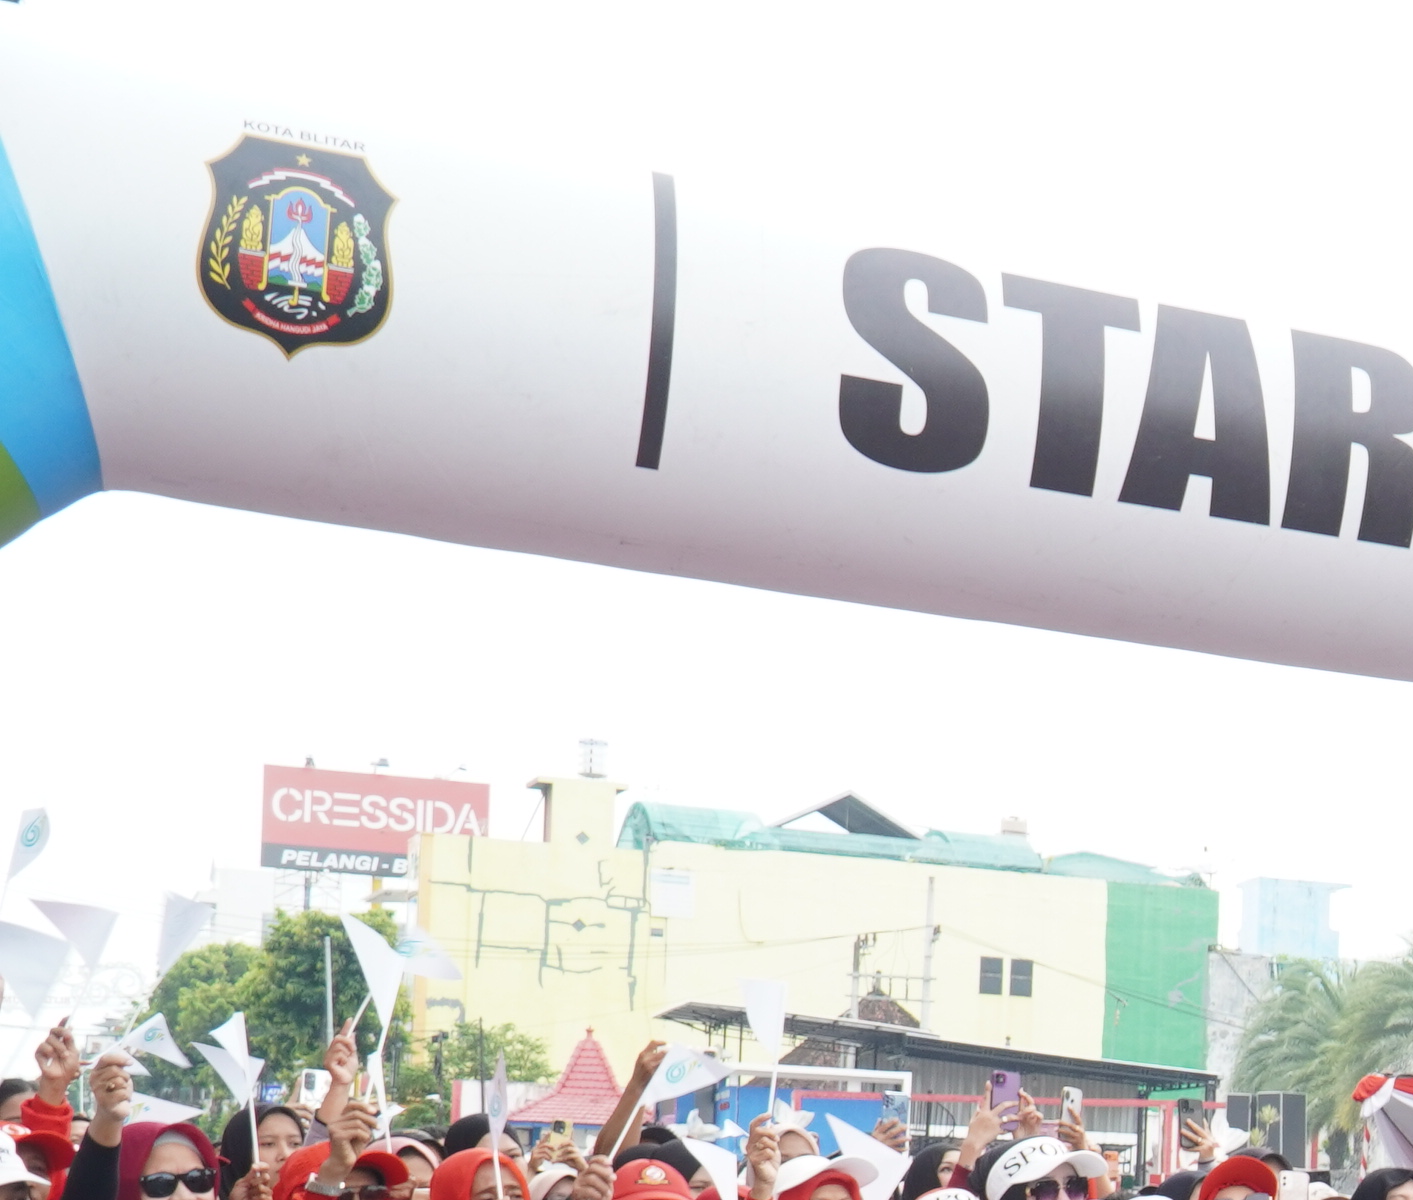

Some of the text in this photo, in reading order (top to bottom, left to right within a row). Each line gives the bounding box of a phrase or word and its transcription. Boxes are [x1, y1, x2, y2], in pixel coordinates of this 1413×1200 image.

[243, 120, 366, 151] KOTA BLITAR
[271, 787, 482, 835] CRESSIDA
[281, 849, 380, 871] PELANGI
